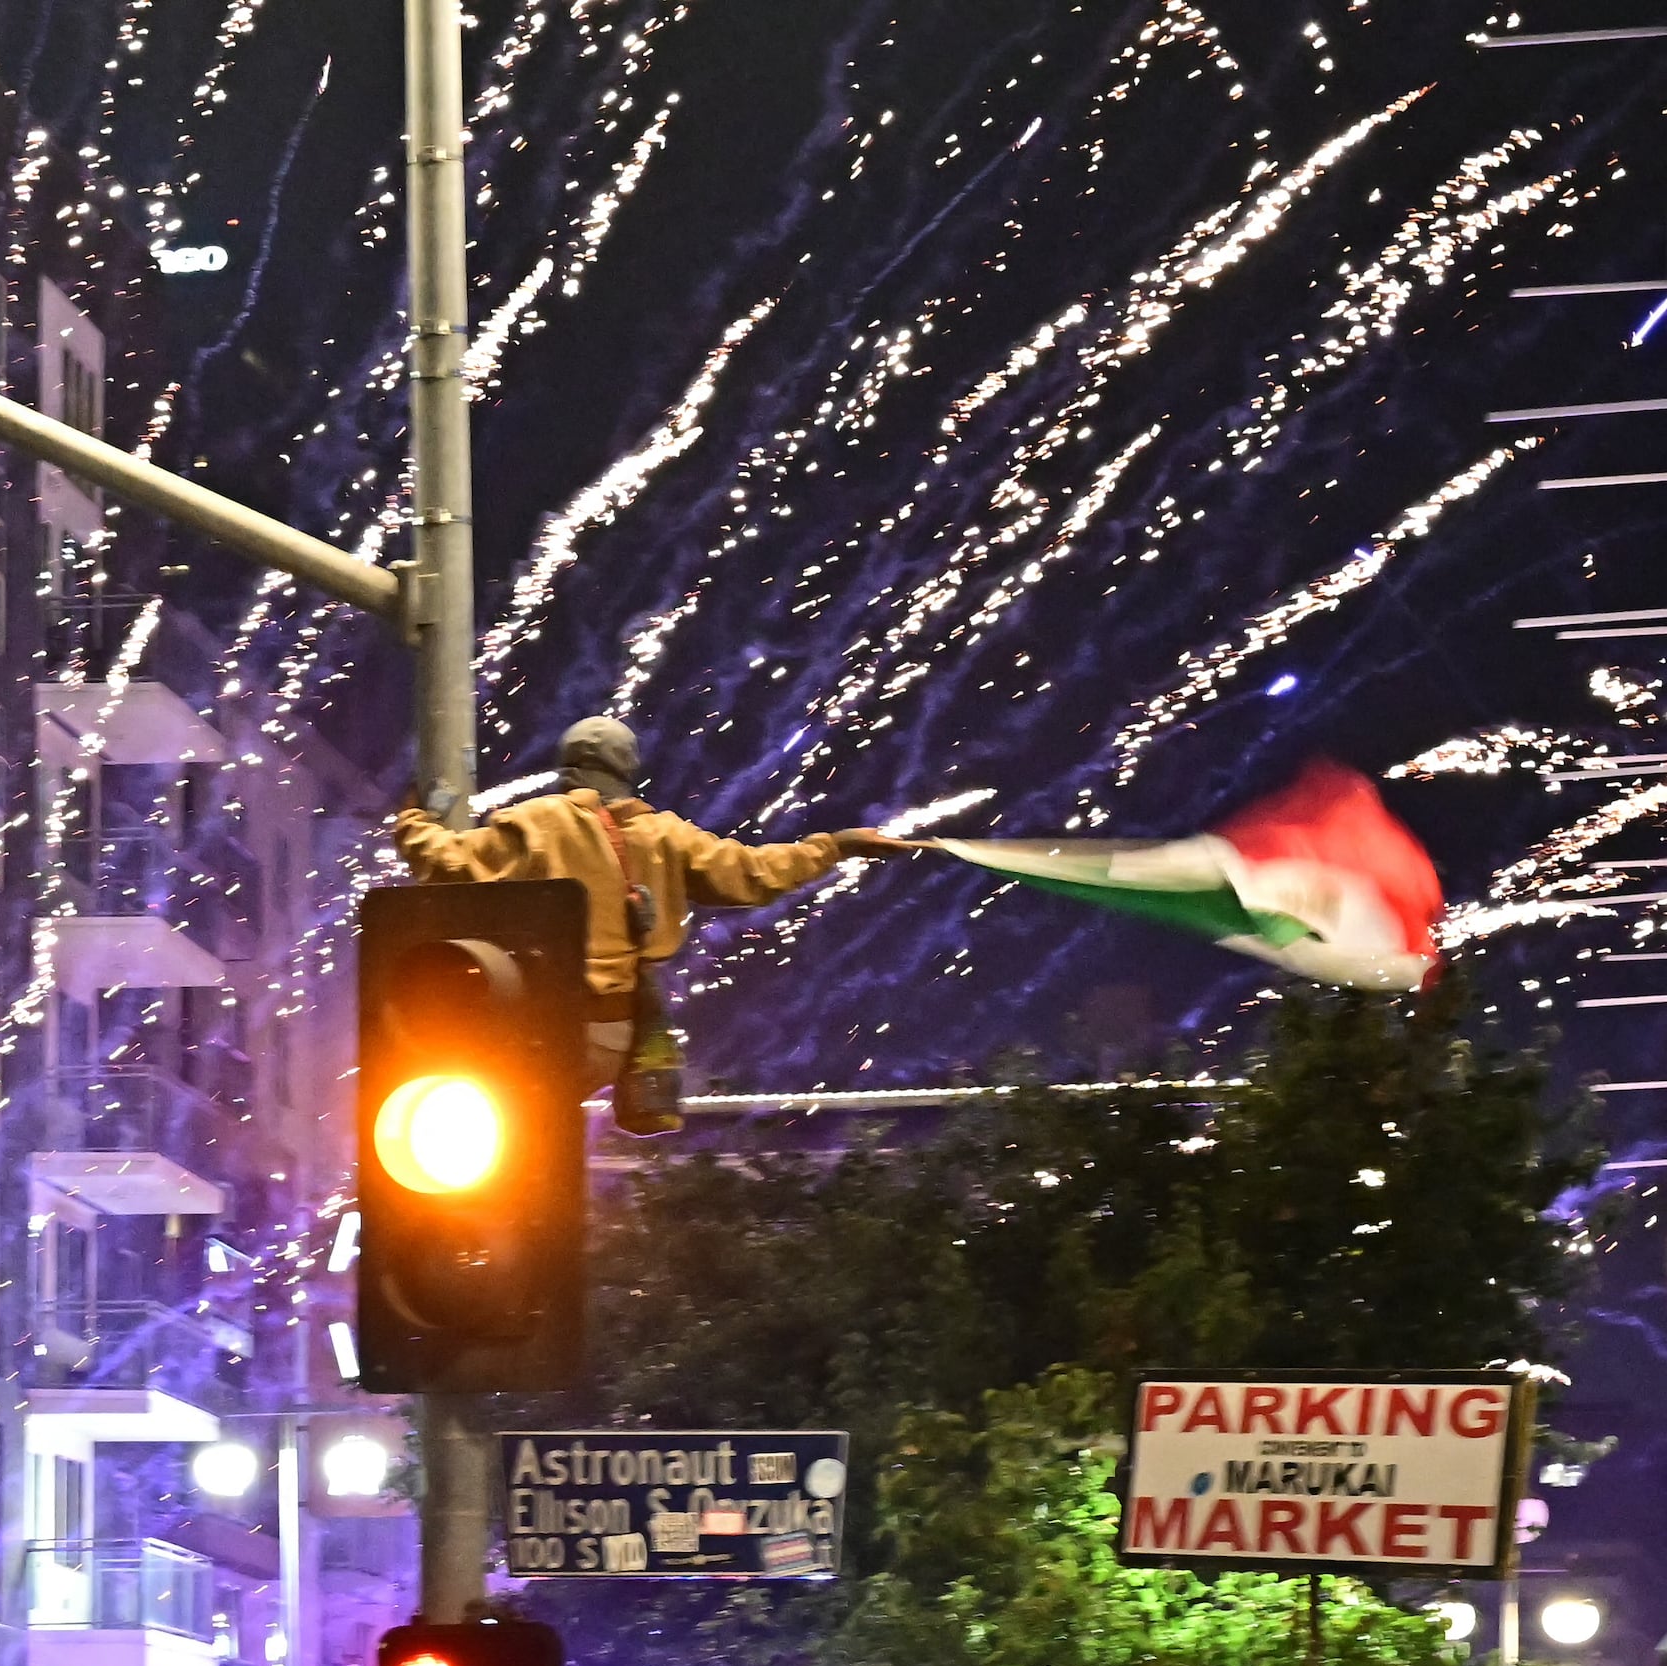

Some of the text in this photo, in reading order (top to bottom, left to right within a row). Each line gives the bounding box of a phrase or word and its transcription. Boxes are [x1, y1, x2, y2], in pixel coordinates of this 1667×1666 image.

[1138, 1385, 1507, 1439] PARKING
[512, 1438, 738, 1486] Astronaut
[1223, 1460, 1398, 1498] MARUKAI
[1129, 1496, 1496, 1561] MARKET
[510, 1537, 566, 1570] 100
[574, 1537, 600, 1570] S
